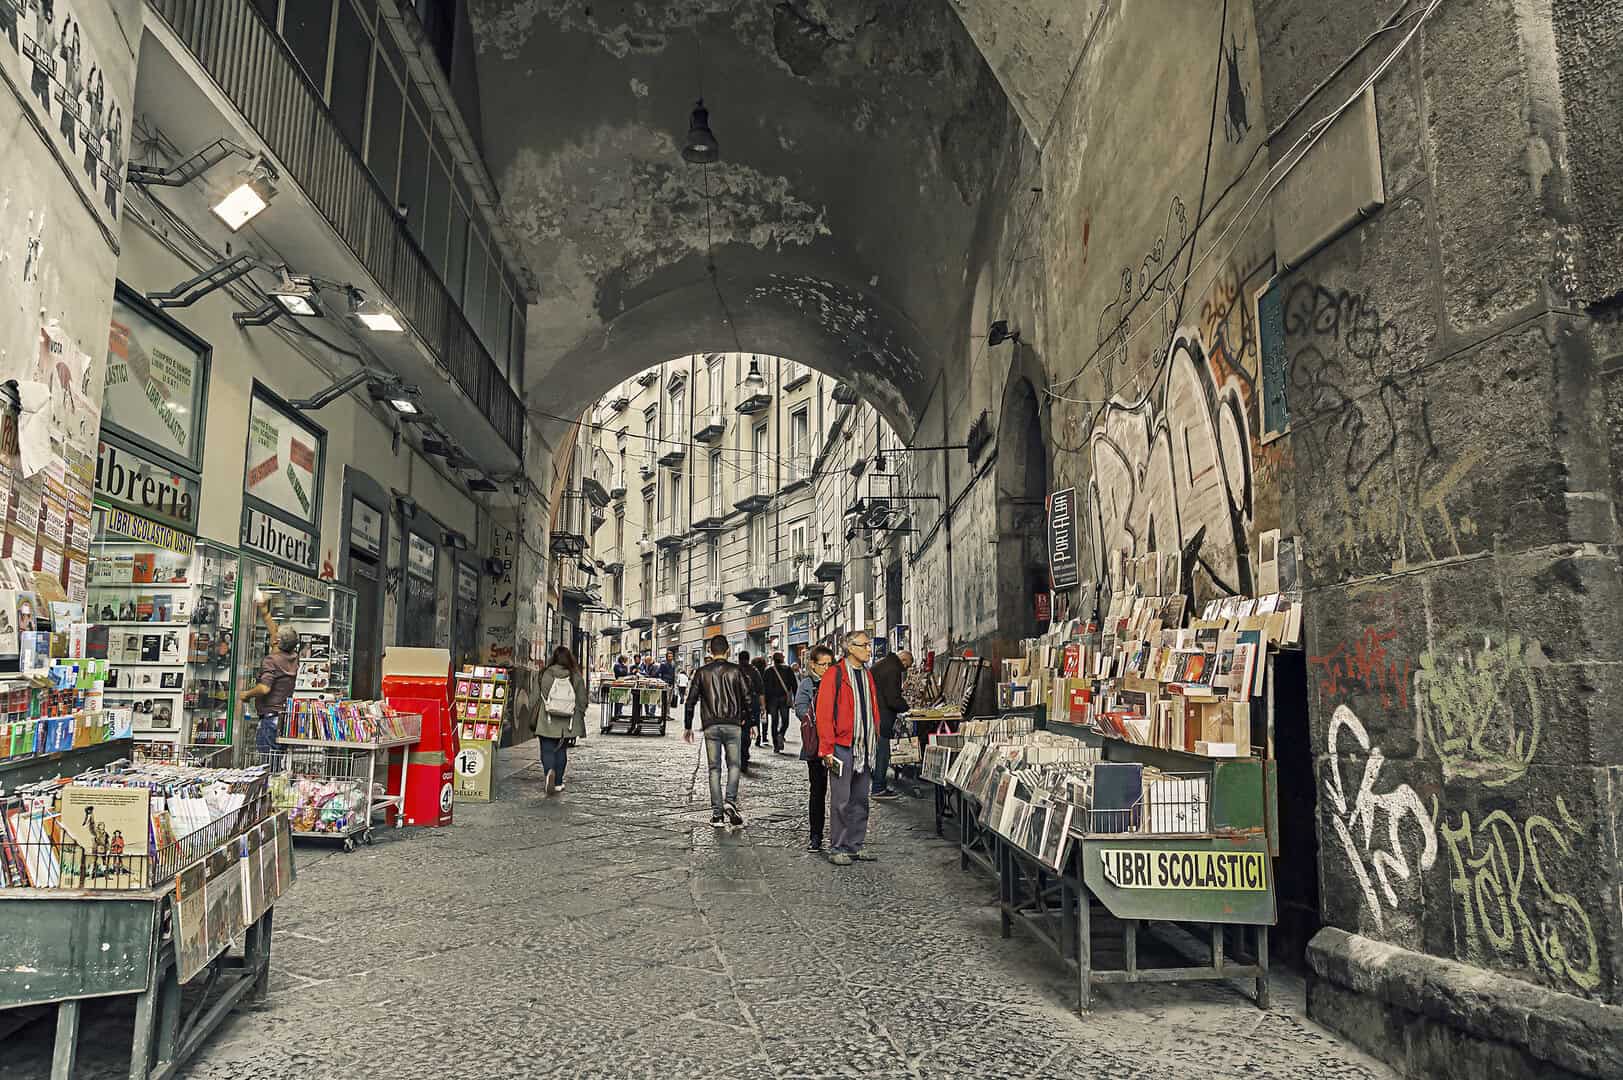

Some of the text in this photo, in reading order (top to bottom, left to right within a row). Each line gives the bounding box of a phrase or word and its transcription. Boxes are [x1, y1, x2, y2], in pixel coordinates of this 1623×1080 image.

[108, 510, 131, 535] LIBRI
[131, 516, 174, 550] SCOLASTICI
[174, 532, 193, 555] USATI
[503, 530, 513, 585] ALBA
[1105, 852, 1264, 889] LIBRI SCOLASTICI
